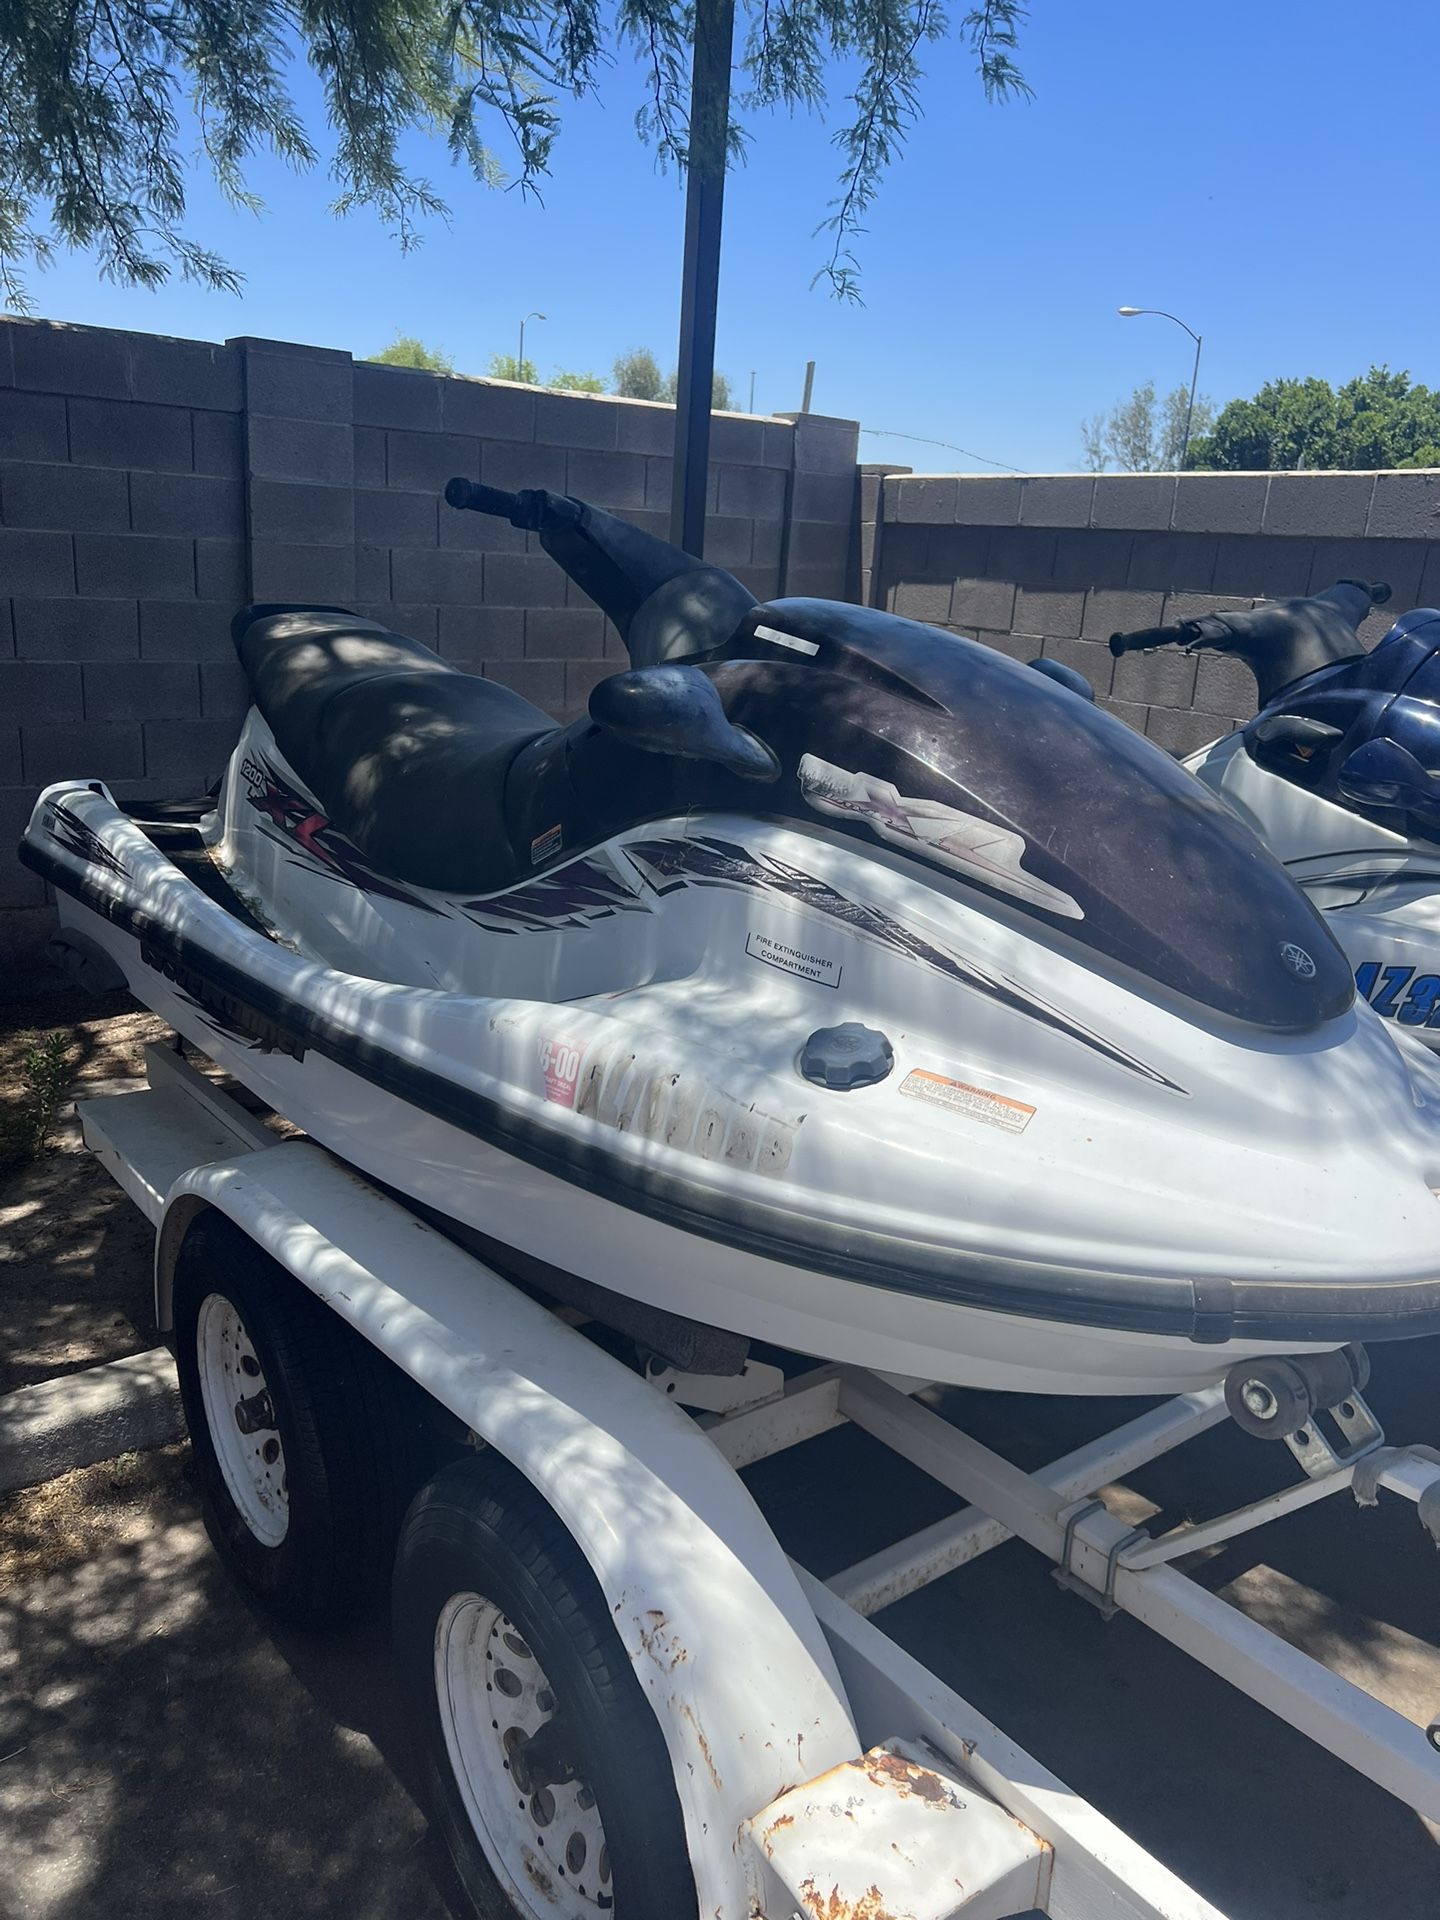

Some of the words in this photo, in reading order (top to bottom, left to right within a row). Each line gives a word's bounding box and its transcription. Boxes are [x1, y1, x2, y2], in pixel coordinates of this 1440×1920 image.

[241, 759, 264, 787] 1200
[756, 934, 772, 947] FIRE
[774, 942, 833, 969] EXTINGUISHER
[761, 950, 822, 978] COMPARTMENT
